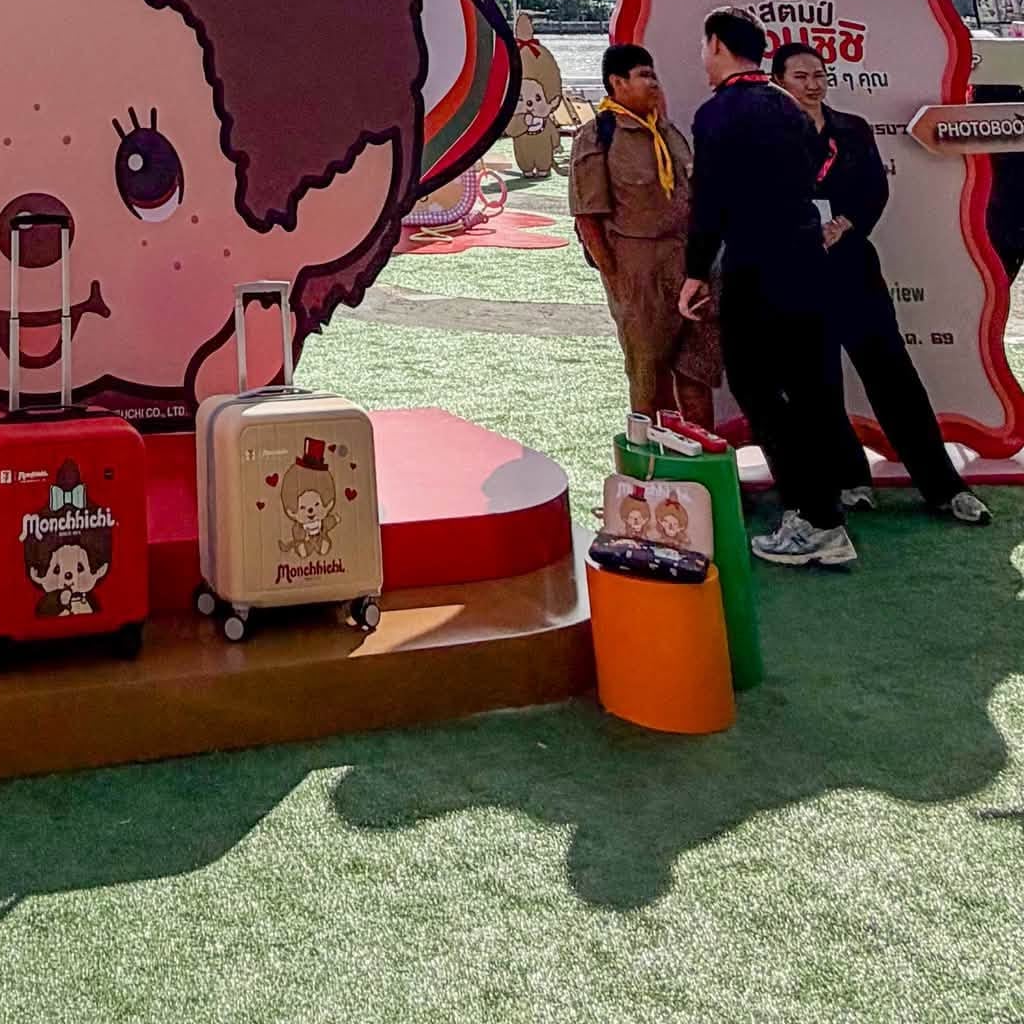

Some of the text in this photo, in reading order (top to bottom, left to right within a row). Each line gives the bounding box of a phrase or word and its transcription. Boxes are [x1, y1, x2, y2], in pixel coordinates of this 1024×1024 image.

[937, 119, 1024, 138] PHOTOBOO
[120, 408, 144, 419] UCHI
[19, 507, 116, 542] Monchhichi
[275, 558, 346, 585] Monchhichi
